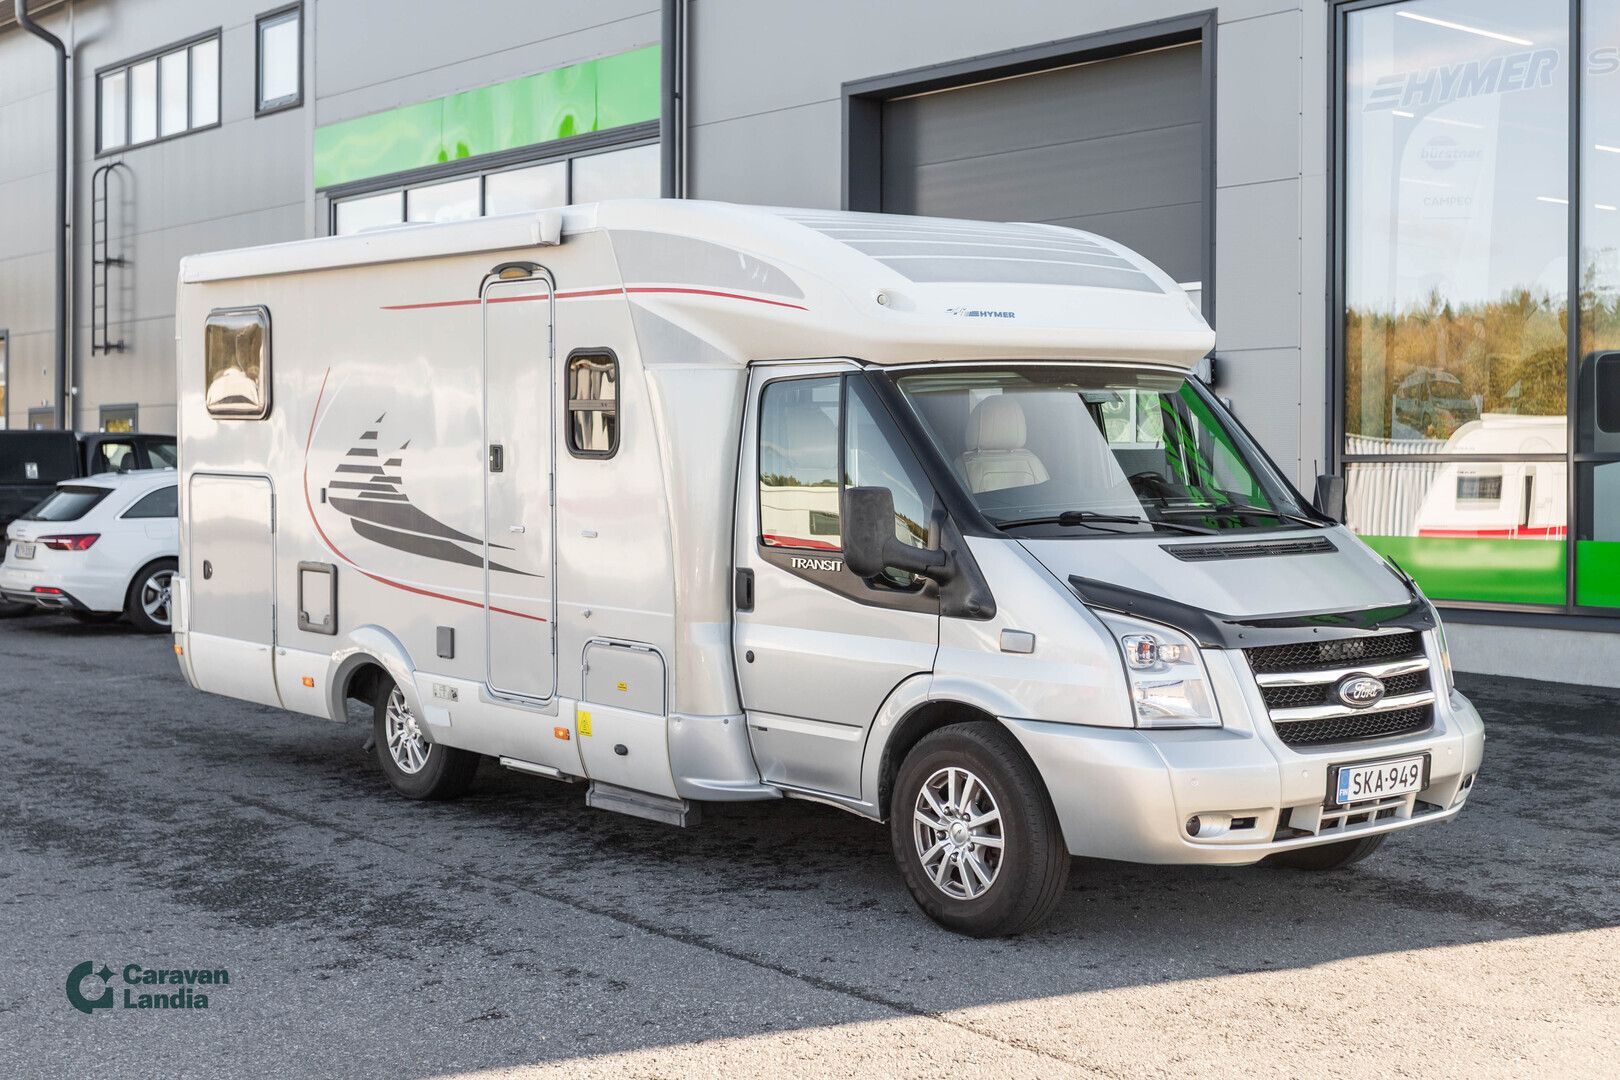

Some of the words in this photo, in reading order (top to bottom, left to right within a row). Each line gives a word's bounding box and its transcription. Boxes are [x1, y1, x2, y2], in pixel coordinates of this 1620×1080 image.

[1401, 48, 1560, 108] HYMER
[979, 310, 1016, 319] HYMER
[790, 557, 843, 572] TRANSIT
[1352, 682, 1378, 699] Ford
[1352, 764, 1419, 796] SKA-949
